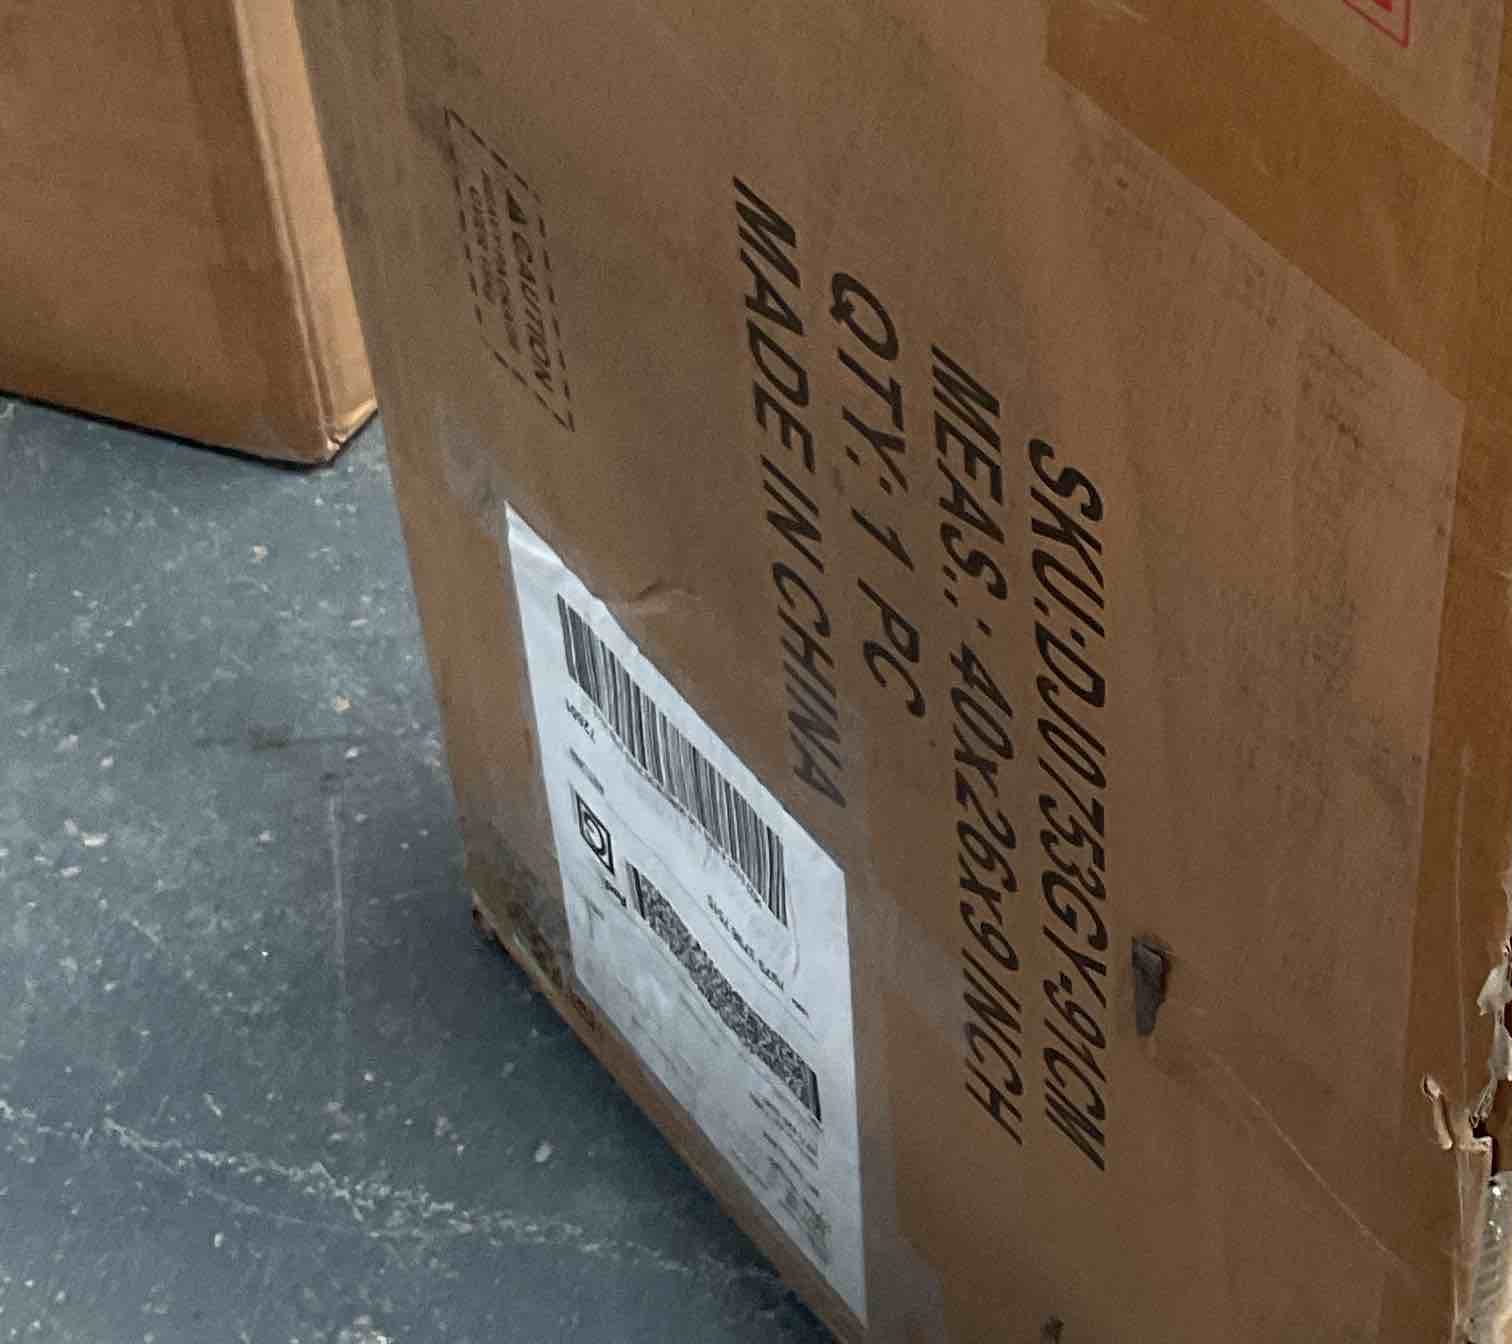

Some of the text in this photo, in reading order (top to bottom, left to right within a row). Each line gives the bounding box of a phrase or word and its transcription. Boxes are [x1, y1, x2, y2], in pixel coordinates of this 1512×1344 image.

[512, 229, 554, 394] CAUTION
[733, 174, 847, 809] MADE IN CHINA
[829, 272, 926, 717] QTY: 1 PC
[961, 948, 1023, 1145] INCH
